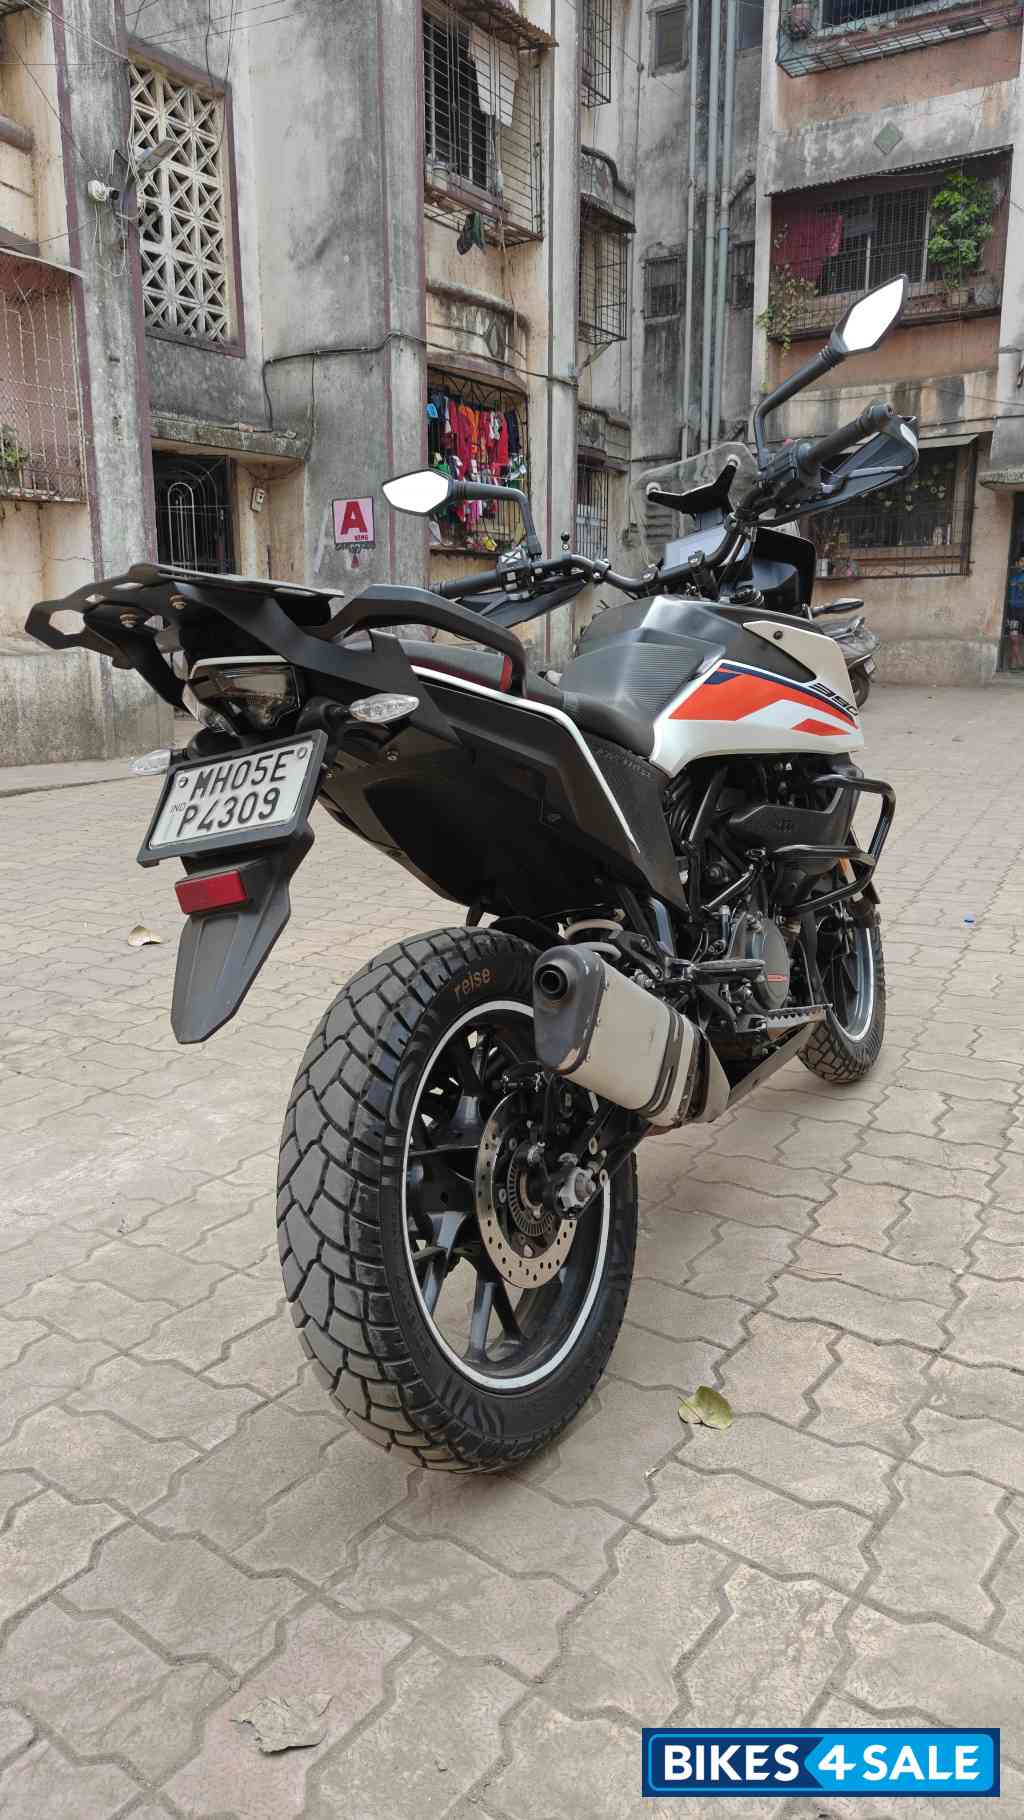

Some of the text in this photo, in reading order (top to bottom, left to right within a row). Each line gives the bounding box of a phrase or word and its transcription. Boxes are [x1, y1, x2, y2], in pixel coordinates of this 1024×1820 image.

[340, 501, 369, 535] A
[189, 749, 295, 801] MH05E
[176, 786, 281, 838] P4309
